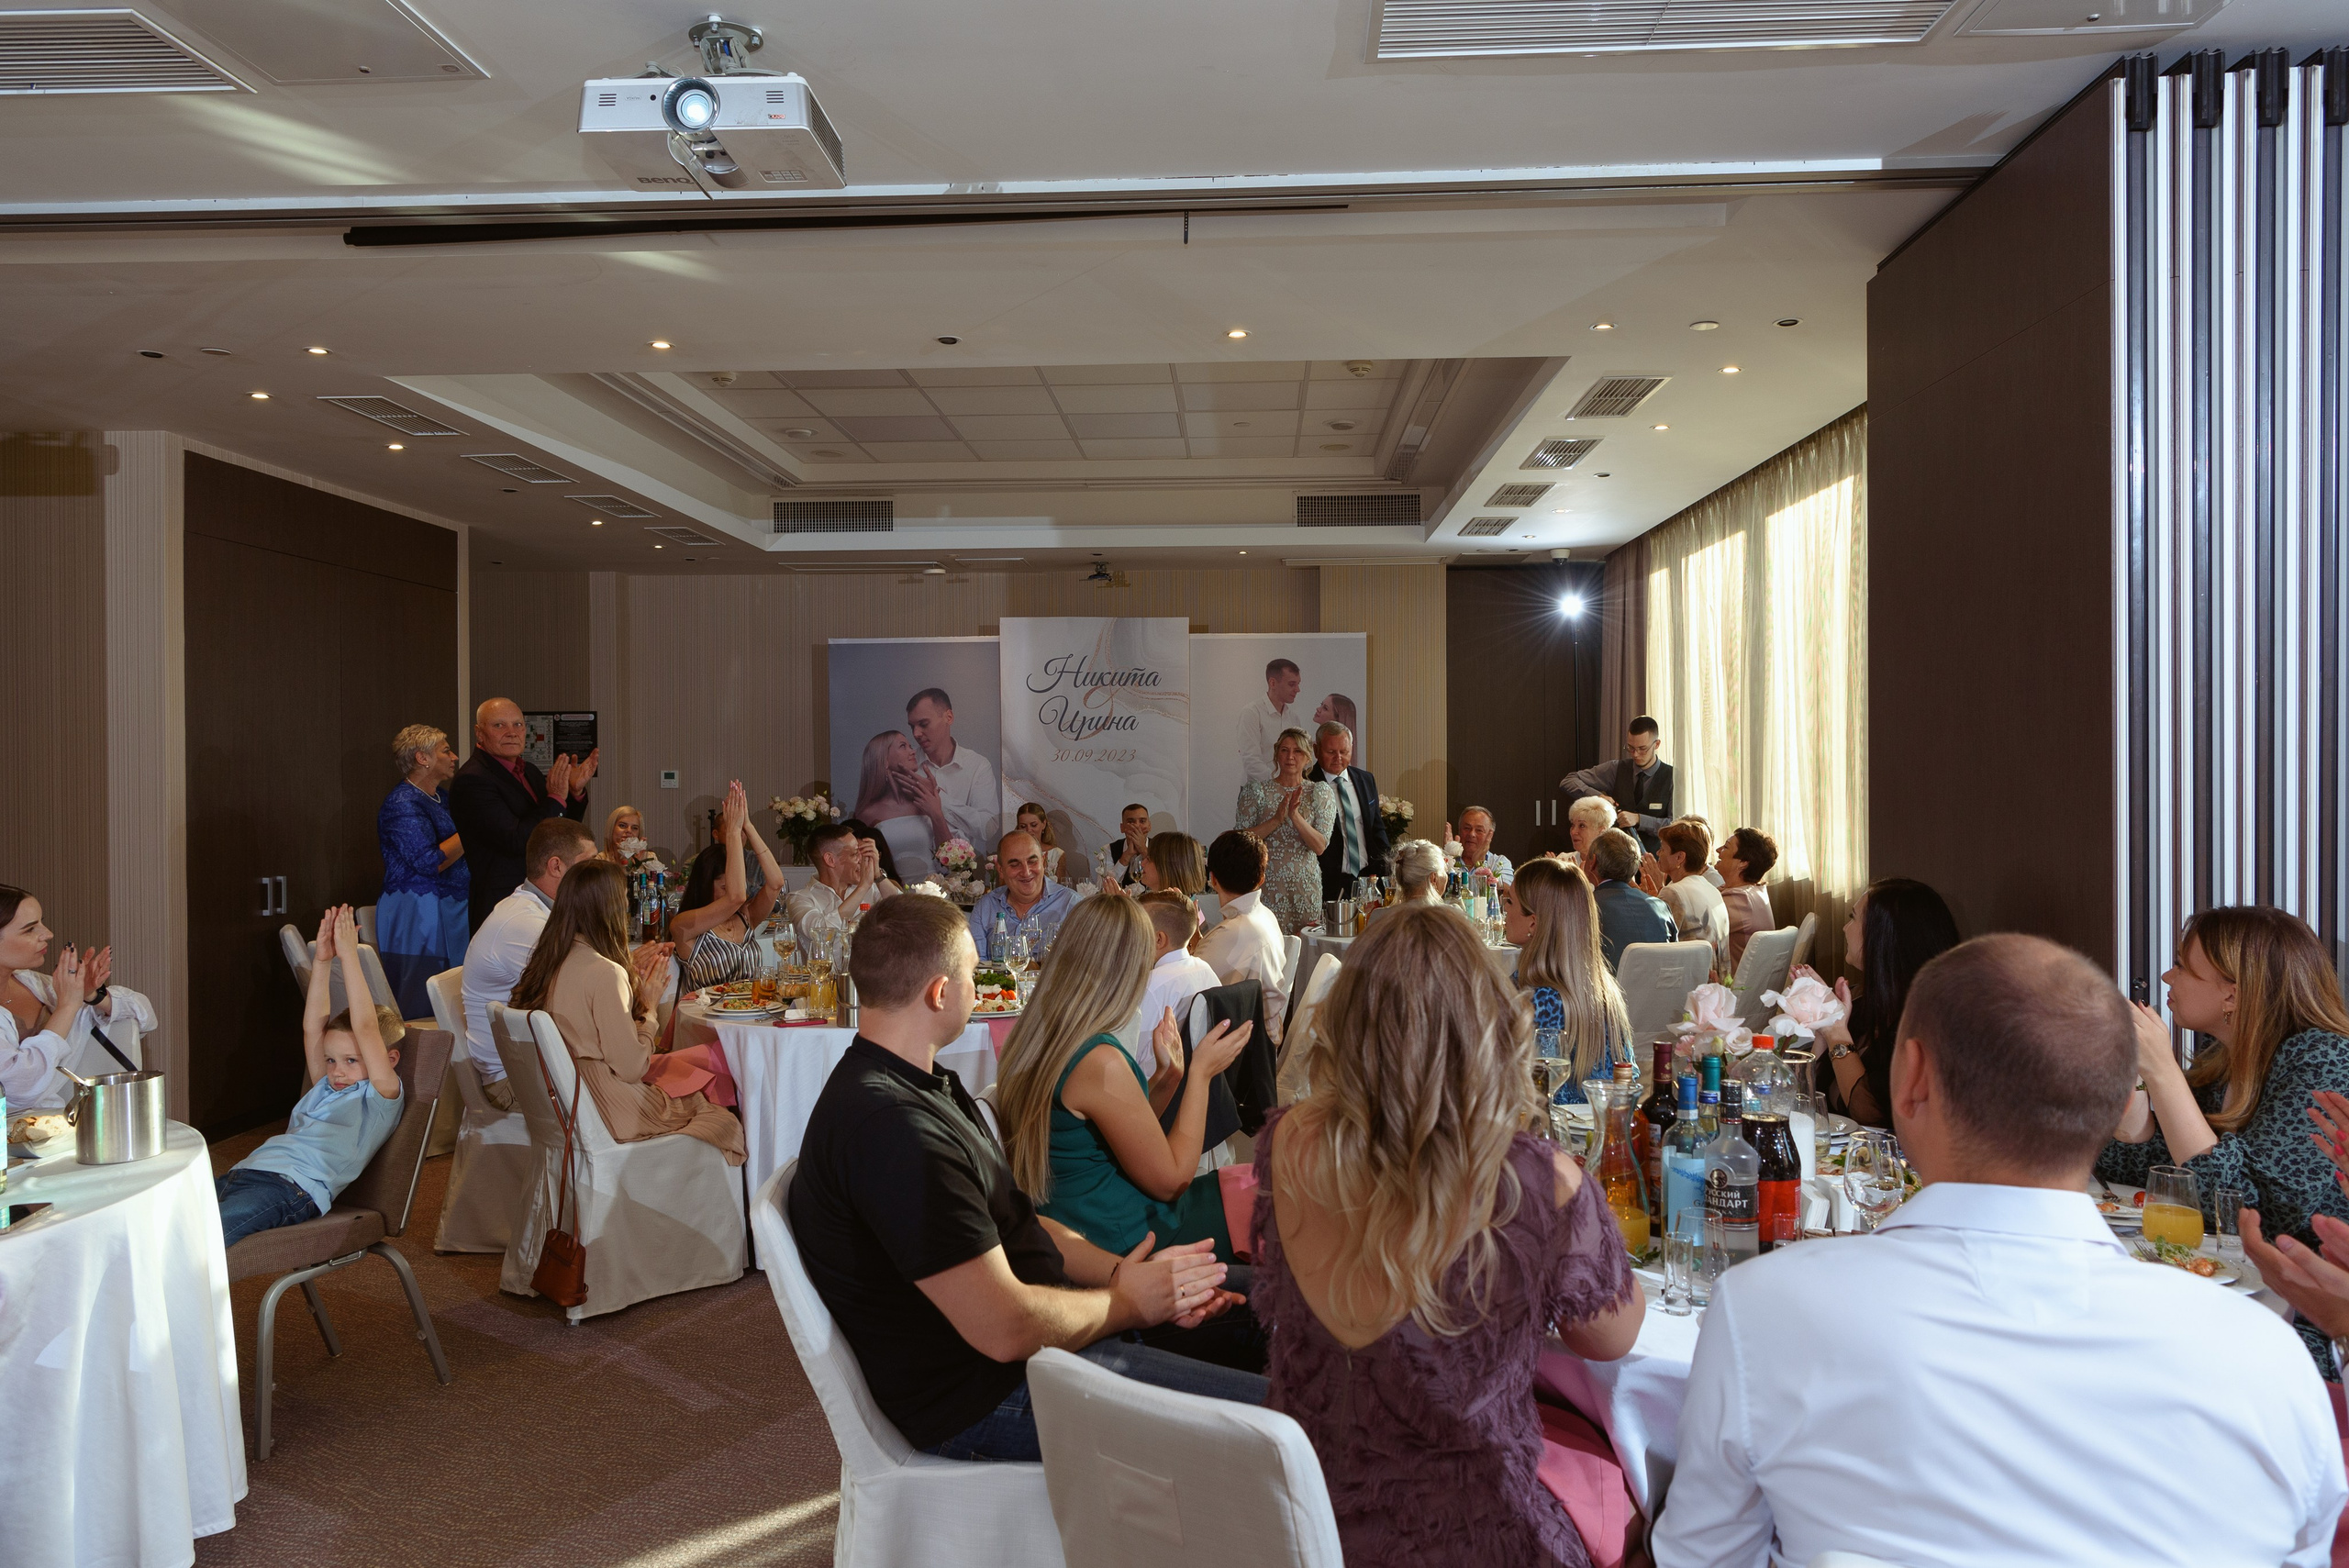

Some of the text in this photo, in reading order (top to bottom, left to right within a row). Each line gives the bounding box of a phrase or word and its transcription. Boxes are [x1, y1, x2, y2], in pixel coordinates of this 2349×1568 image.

[1026, 653, 1162, 693] Никита
[1039, 695, 1140, 741] Ирина
[1051, 749, 1138, 762] 30.09.2023
